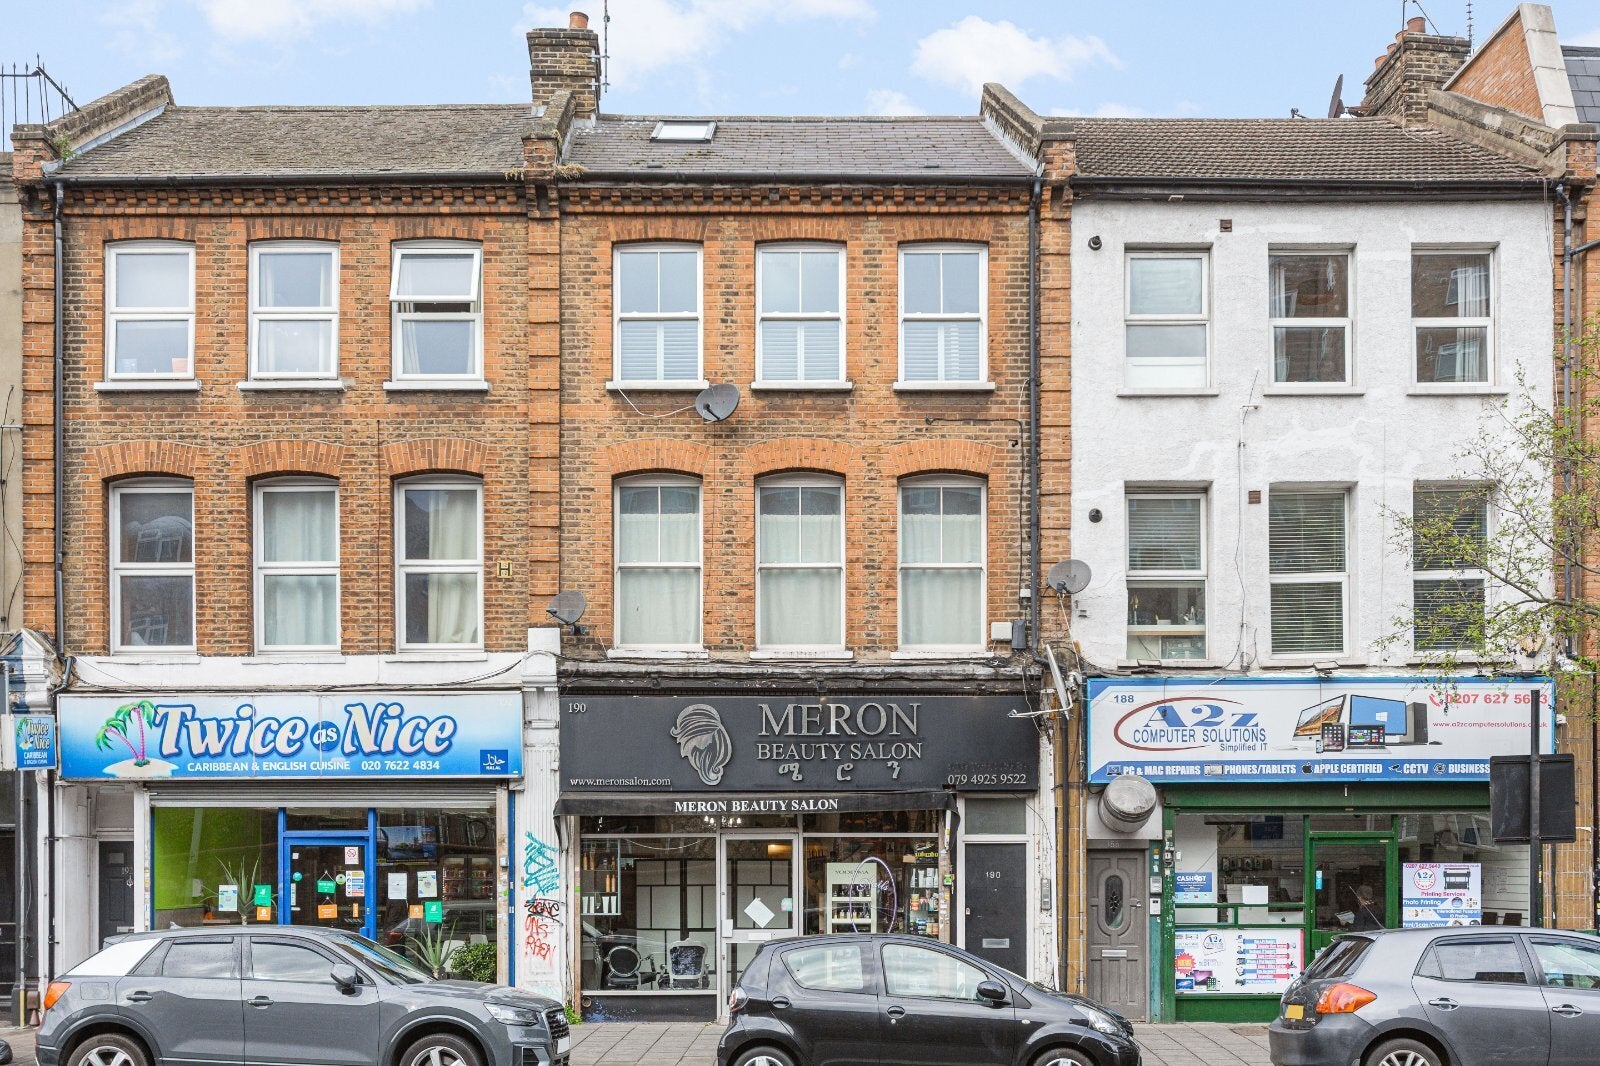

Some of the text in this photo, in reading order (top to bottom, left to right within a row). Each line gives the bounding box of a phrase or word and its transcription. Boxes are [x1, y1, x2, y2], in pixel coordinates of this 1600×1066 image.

[1113, 695, 1134, 703] 188
[1446, 693, 1548, 704] 0207 627 563
[567, 703, 587, 713] 190
[758, 703, 921, 736] MERON
[1143, 704, 1259, 728] A2z
[26, 719, 49, 735] Twice
[153, 702, 457, 758] Twice as Nice
[1133, 728, 1266, 744] COMPUTER SOLUTIONS
[34, 736, 50, 750] Nice
[1220, 742, 1268, 752] Simplified IT
[756, 742, 922, 760] BEAUTY SALON
[187, 760, 440, 772] CARIBBEAN & ENGLISH CUISINE 020 7622 4834
[1123, 763, 1490, 775] PC & MAC REPAIRS PHONES/TABLETS APPLE CERTIFIED CCTV BUSINESS
[570, 776, 671, 786] www.meronsalon.com
[947, 773, 1027, 785] 079 4925 9522
[674, 799, 839, 813] MERON BEAUTY SALON
[985, 871, 1001, 879] 190
